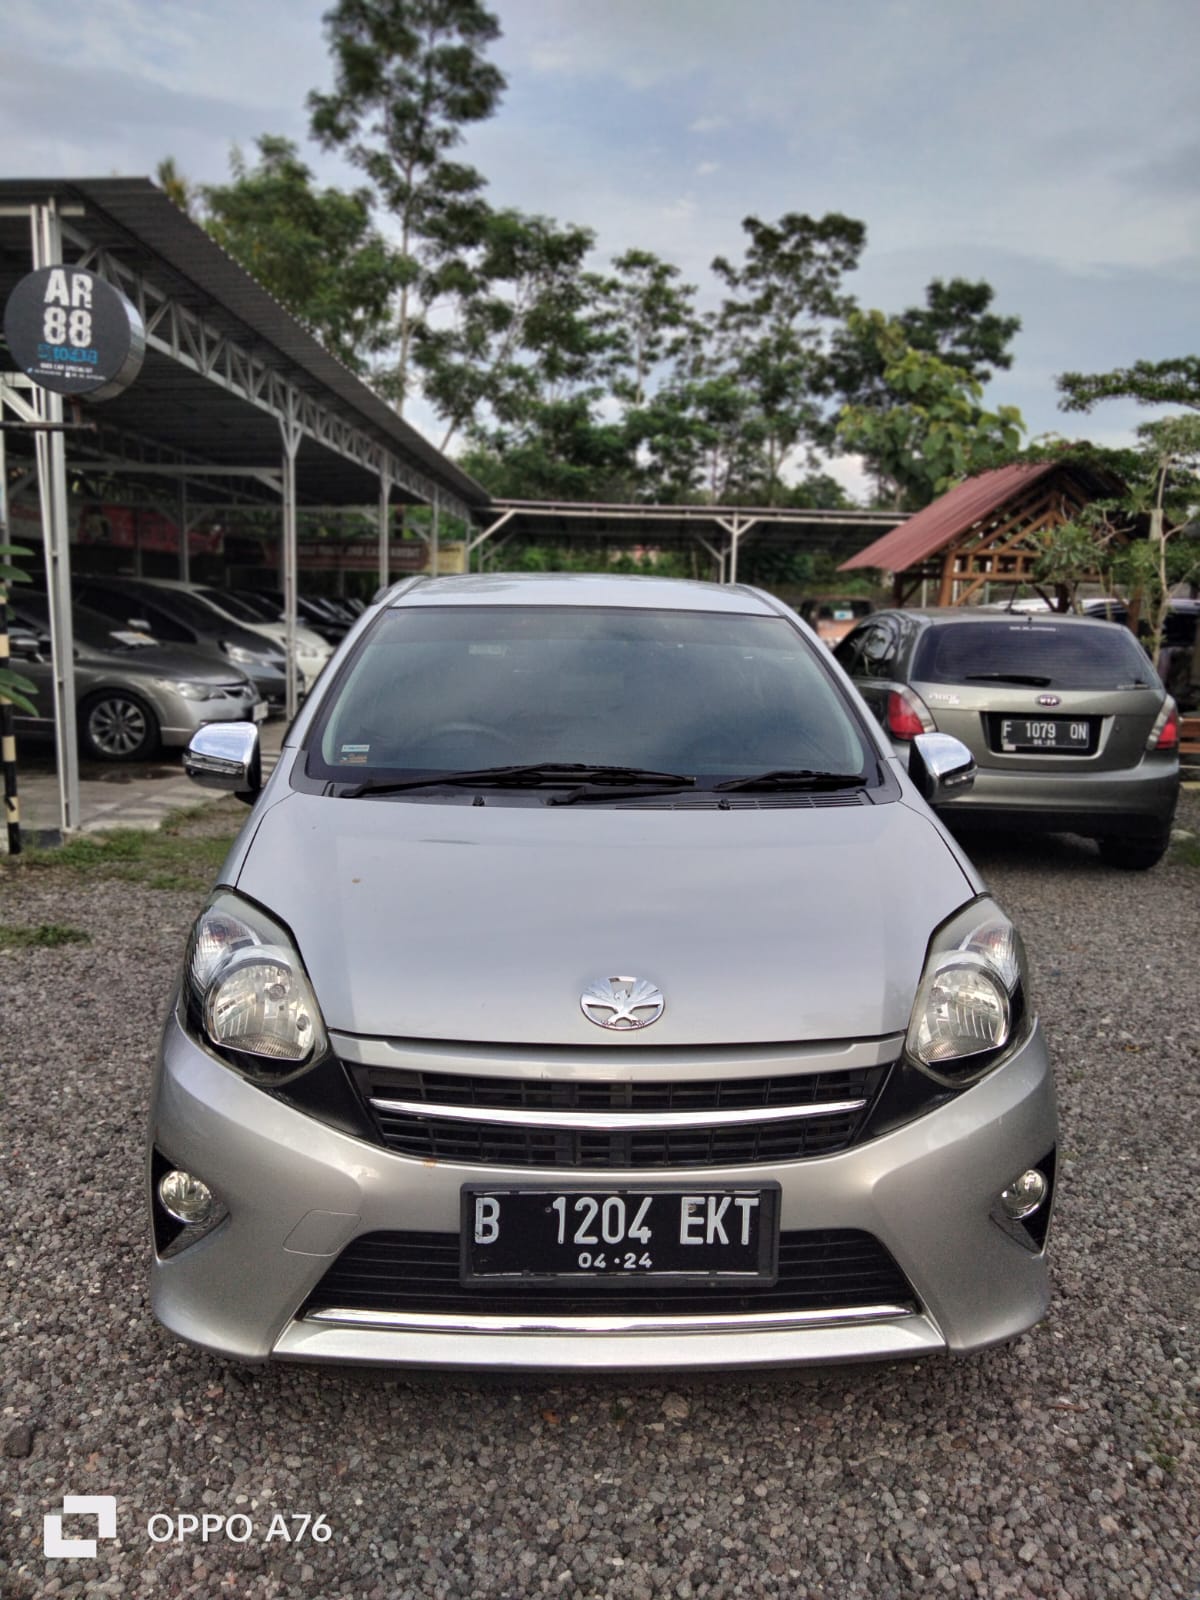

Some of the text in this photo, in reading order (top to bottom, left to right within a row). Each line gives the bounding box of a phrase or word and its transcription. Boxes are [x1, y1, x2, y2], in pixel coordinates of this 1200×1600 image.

[44, 269, 93, 308] AR
[43, 306, 92, 347] 88
[1003, 721, 1012, 737] F
[1025, 722, 1056, 738] 1079
[474, 1197, 759, 1245] B 1204 EKT
